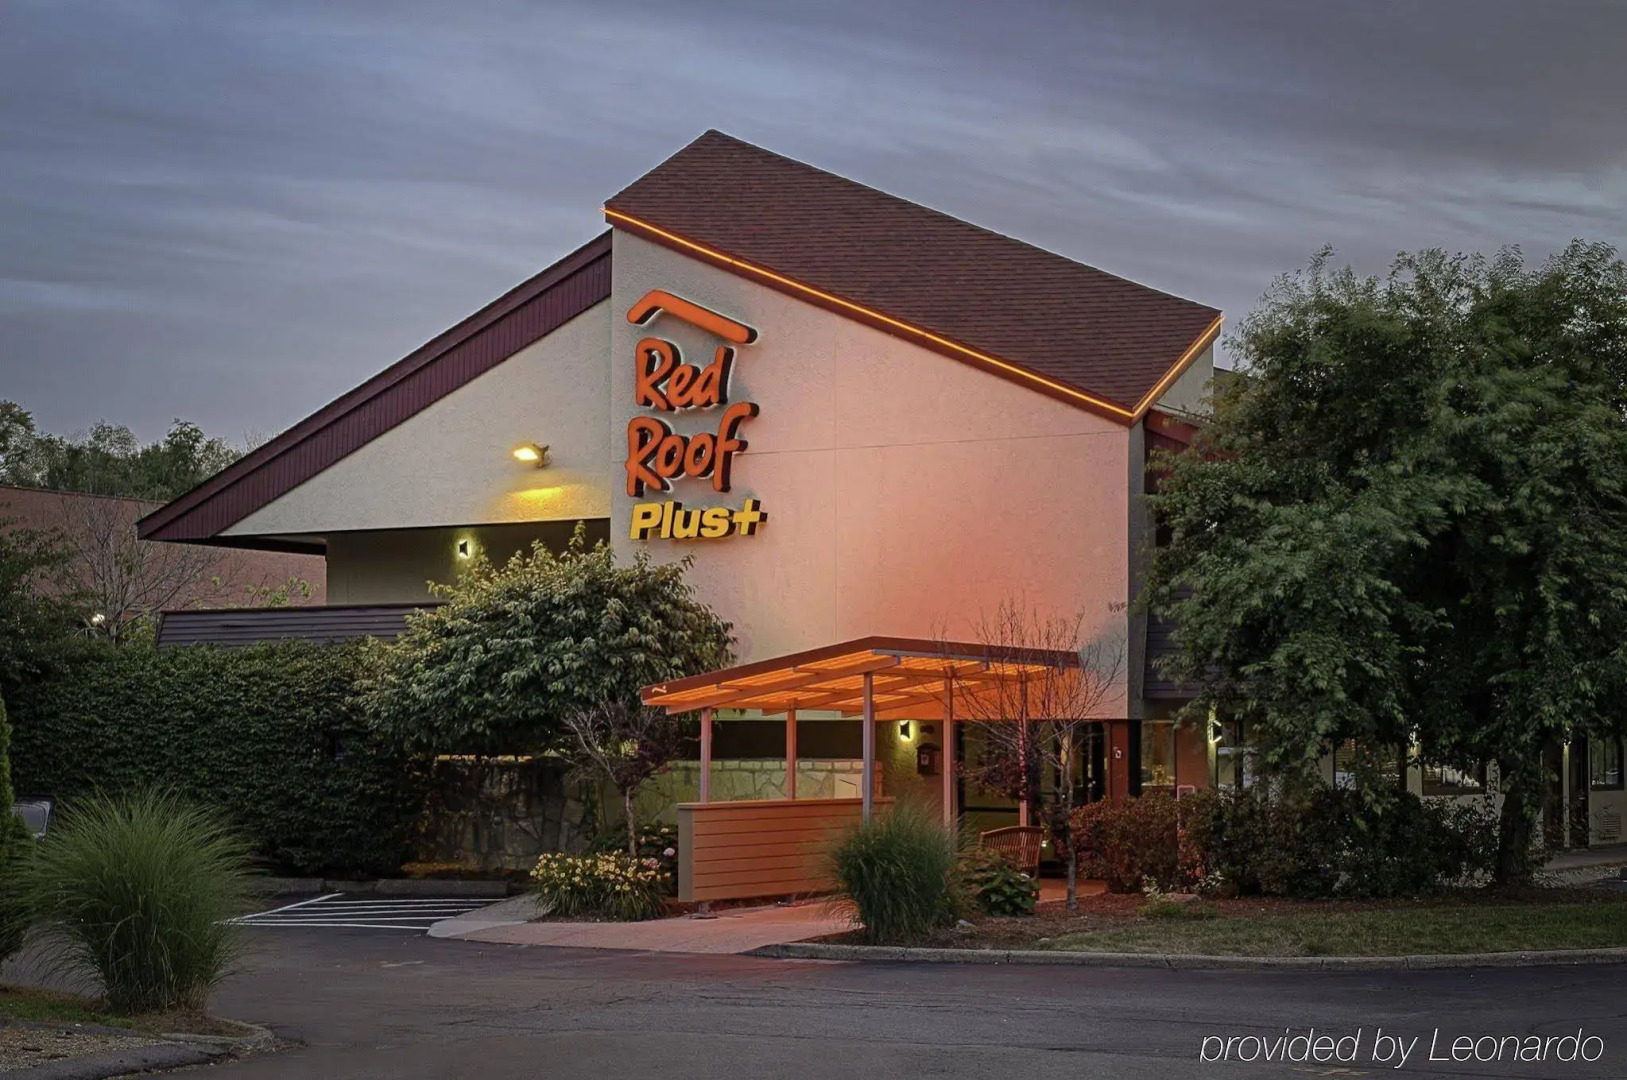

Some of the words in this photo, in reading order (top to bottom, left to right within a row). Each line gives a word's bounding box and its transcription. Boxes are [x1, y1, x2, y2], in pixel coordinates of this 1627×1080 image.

[636, 337, 733, 411] Red
[625, 402, 758, 497] Roof
[630, 499, 768, 540] Plus+
